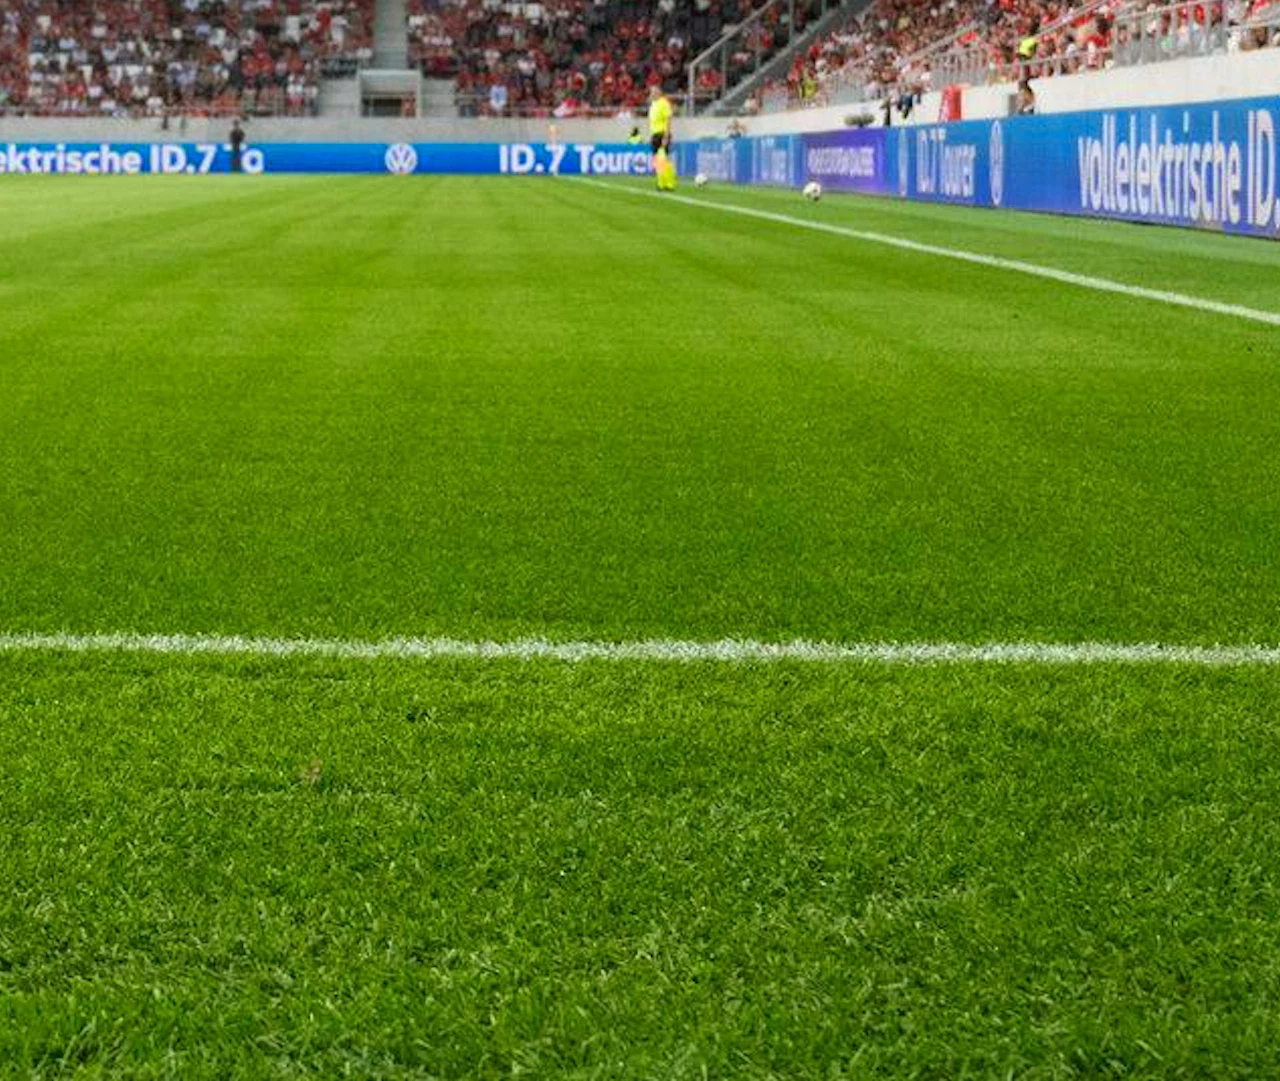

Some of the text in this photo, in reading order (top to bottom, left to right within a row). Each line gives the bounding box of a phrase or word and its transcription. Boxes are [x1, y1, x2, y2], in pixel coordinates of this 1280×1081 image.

[149, 144, 217, 173] ID.7
[499, 143, 567, 173] ID.7
[1078, 110, 1241, 225] vollelektrische
